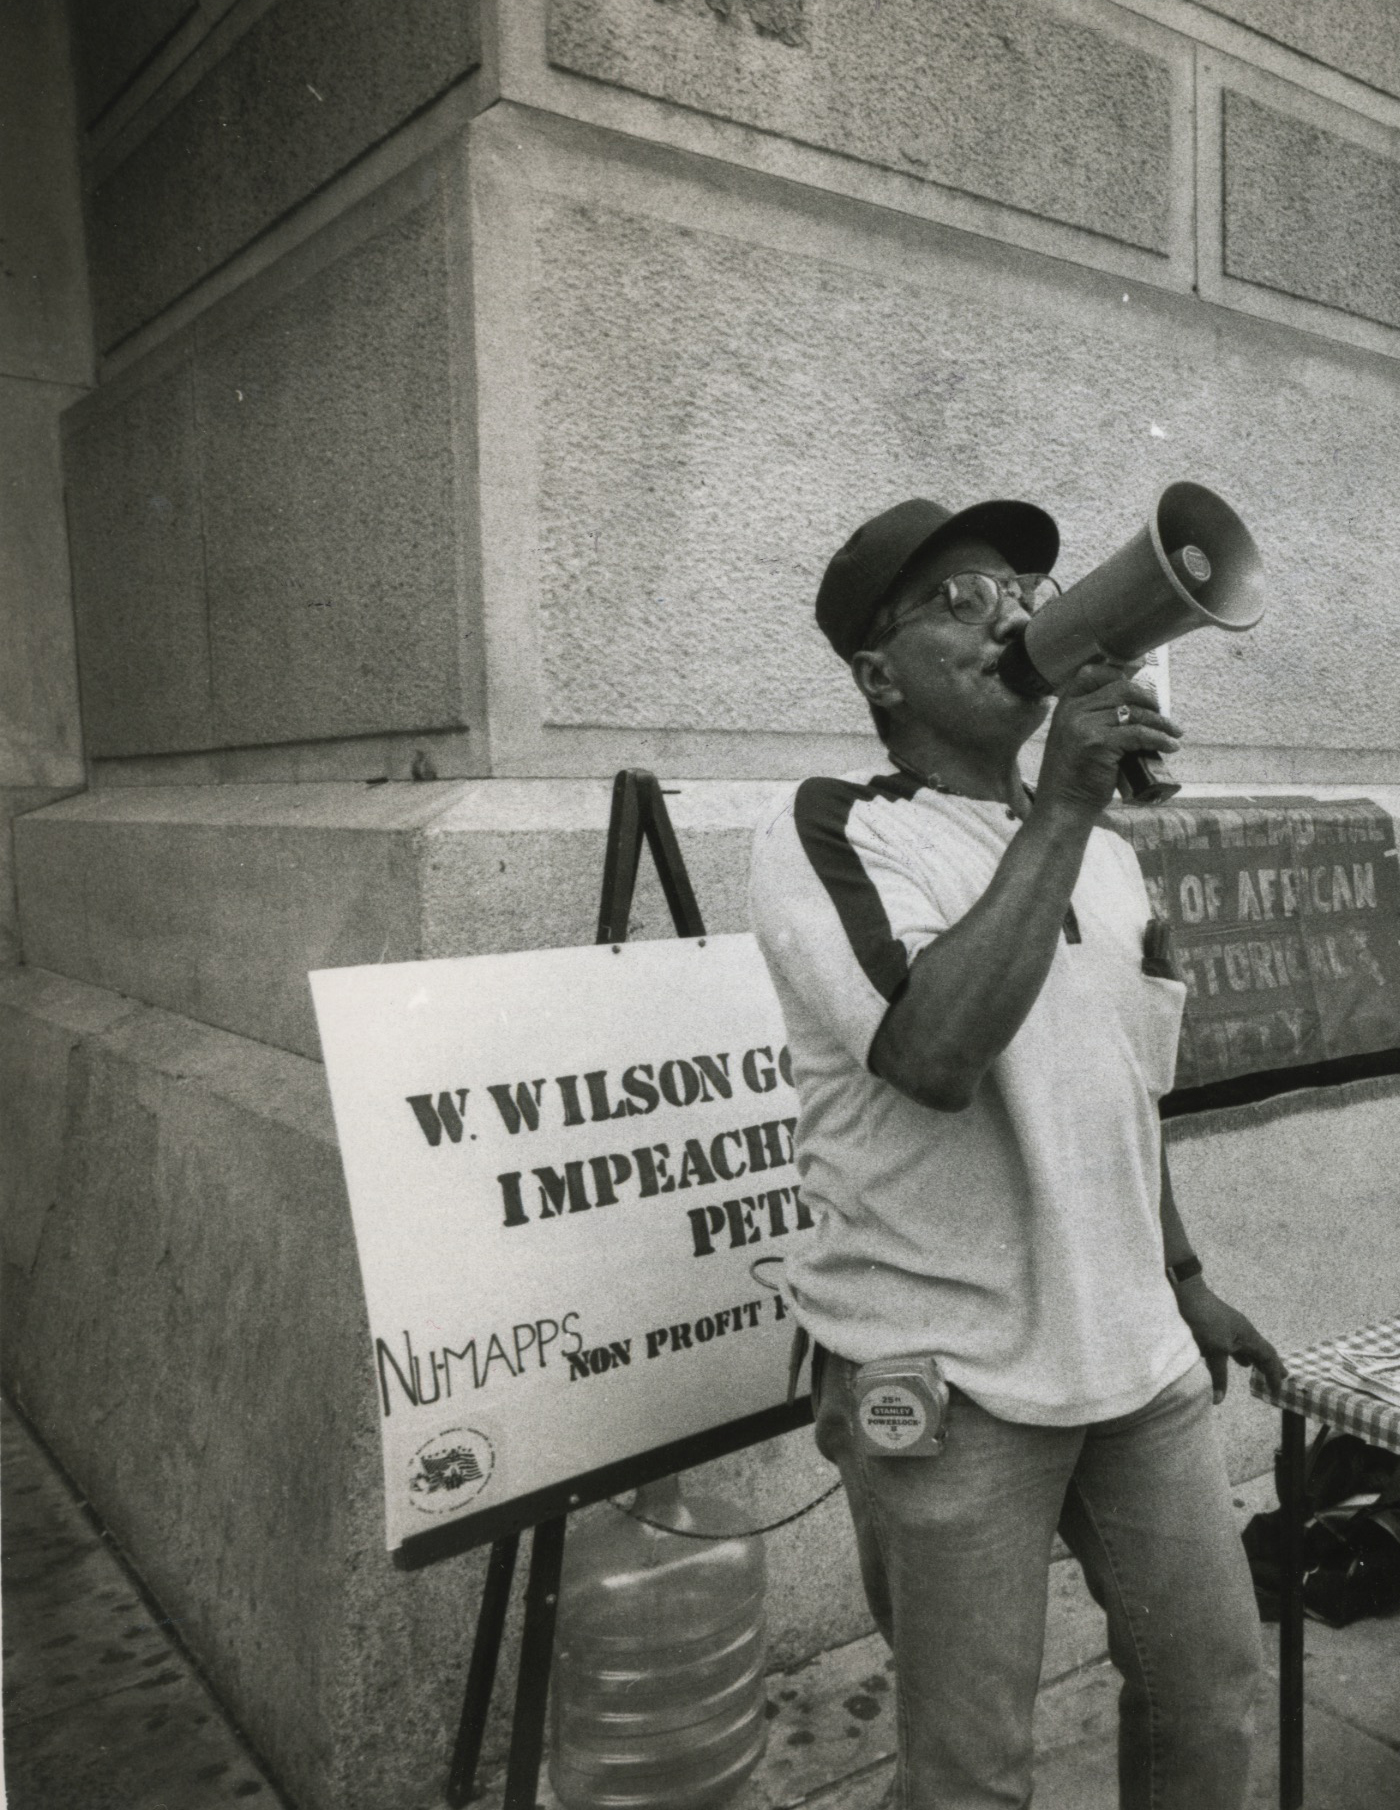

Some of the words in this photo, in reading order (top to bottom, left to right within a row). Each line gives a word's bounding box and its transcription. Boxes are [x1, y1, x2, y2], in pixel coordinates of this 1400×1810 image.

[1180, 873, 1221, 923] OF
[1238, 862, 1377, 921] AFRICAN
[406, 1088, 477, 1147] W.
[487, 1052, 733, 1135] WILSON
[497, 1116, 798, 1227] IMPEACH
[567, 1338, 632, 1381] NON
[646, 1300, 762, 1359] PROFIT
[873, 1407, 912, 1415] STANLEY
